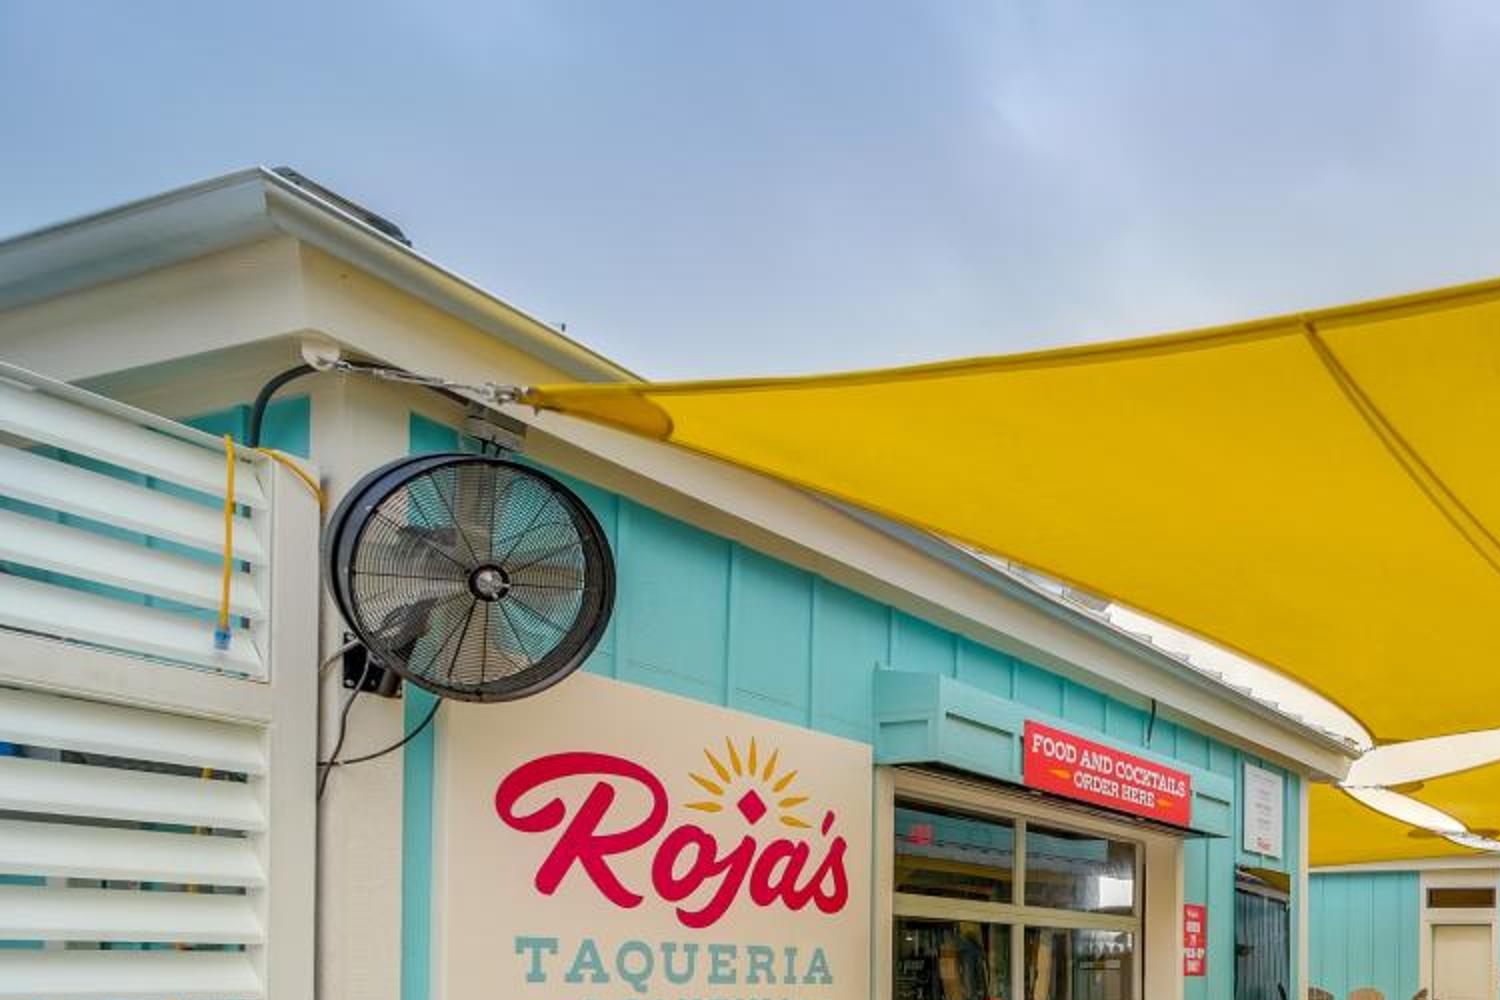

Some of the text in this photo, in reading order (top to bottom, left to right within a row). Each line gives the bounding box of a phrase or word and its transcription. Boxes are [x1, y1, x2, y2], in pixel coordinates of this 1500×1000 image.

[1031, 734, 1185, 797] FOOD AND COCKTAILS
[1073, 771, 1155, 808] ORDER HERE
[495, 752, 848, 928] Roja's
[514, 935, 833, 993] TAQUERIA
